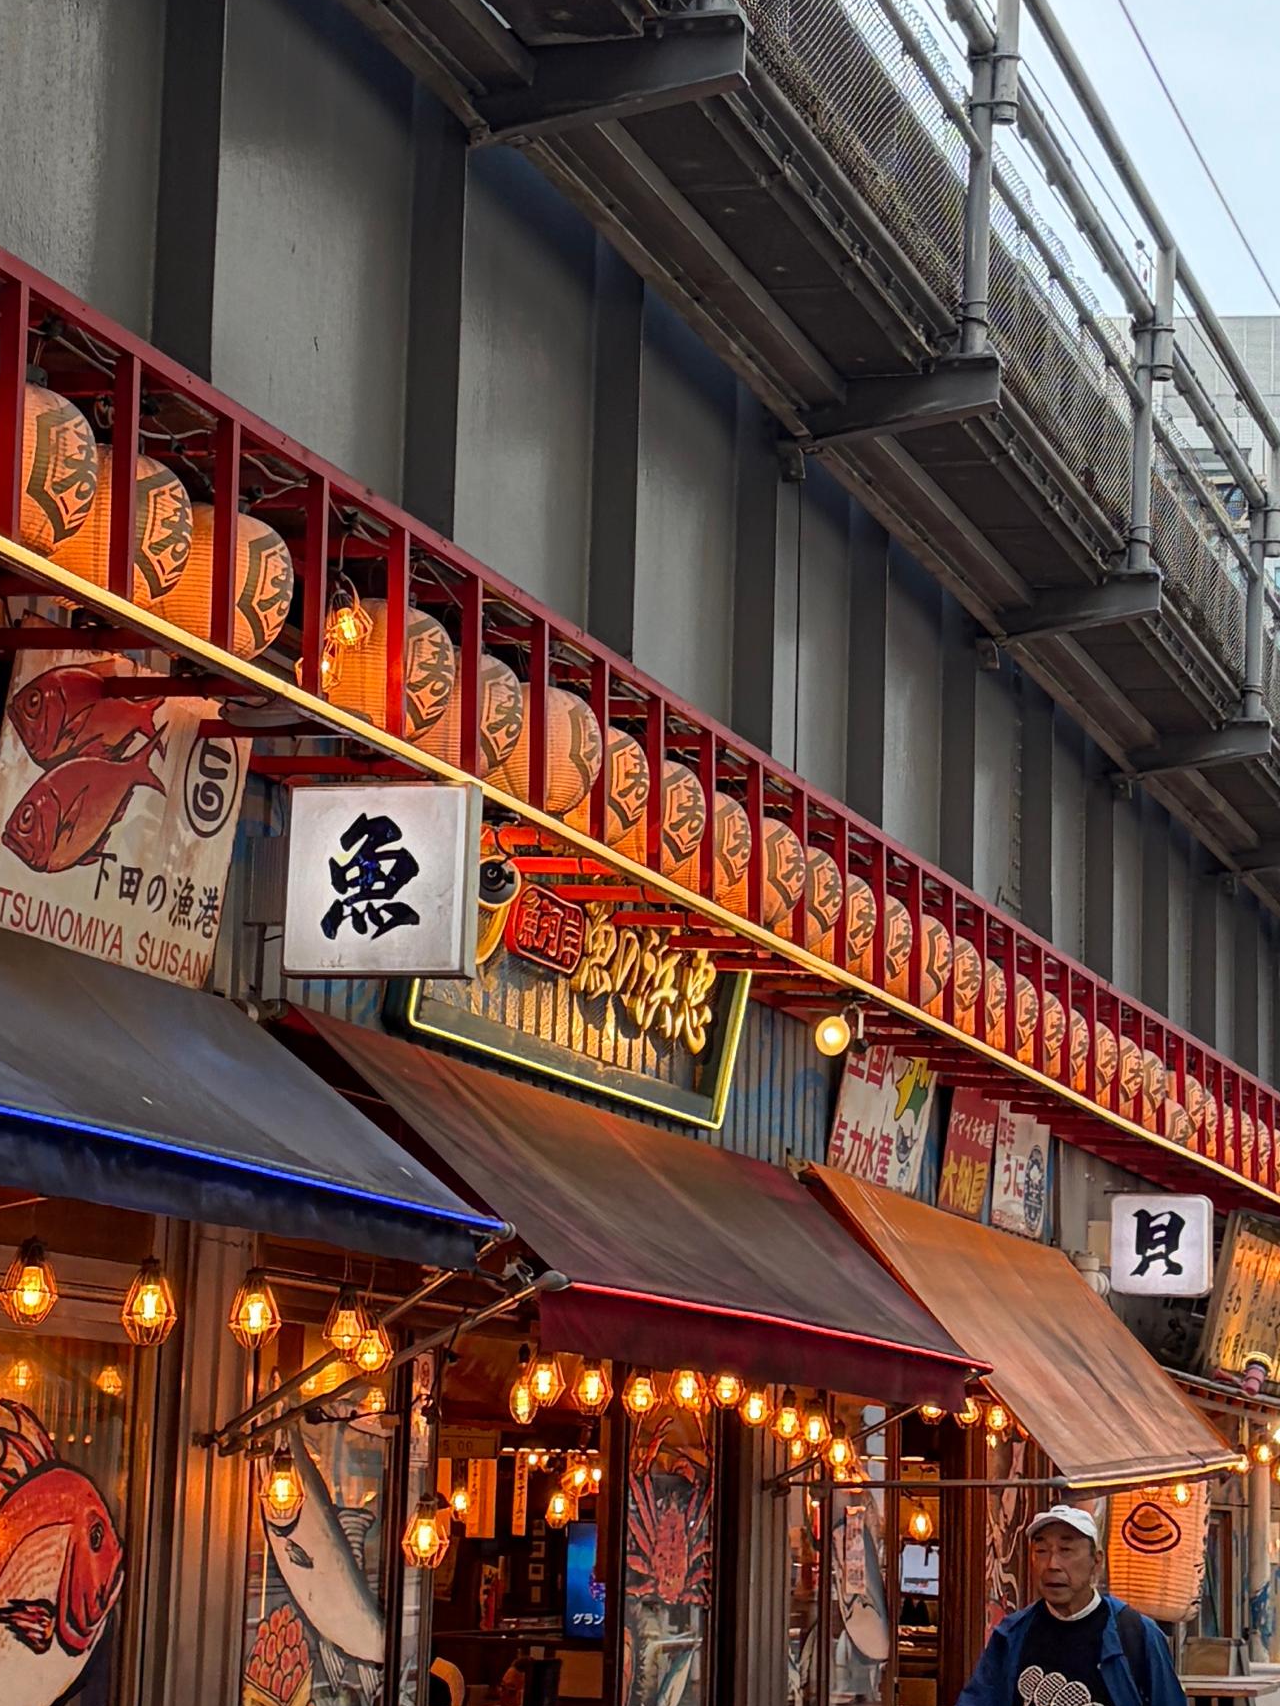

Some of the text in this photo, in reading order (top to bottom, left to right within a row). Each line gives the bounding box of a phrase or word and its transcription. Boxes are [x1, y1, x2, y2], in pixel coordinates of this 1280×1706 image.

[93, 851, 220, 940] 下田の漁港
[320, 811, 421, 941] 魚
[135, 930, 209, 983] SUISAN
[519, 889, 581, 967] 魚河岸
[1129, 1208, 1186, 1278] 貝
